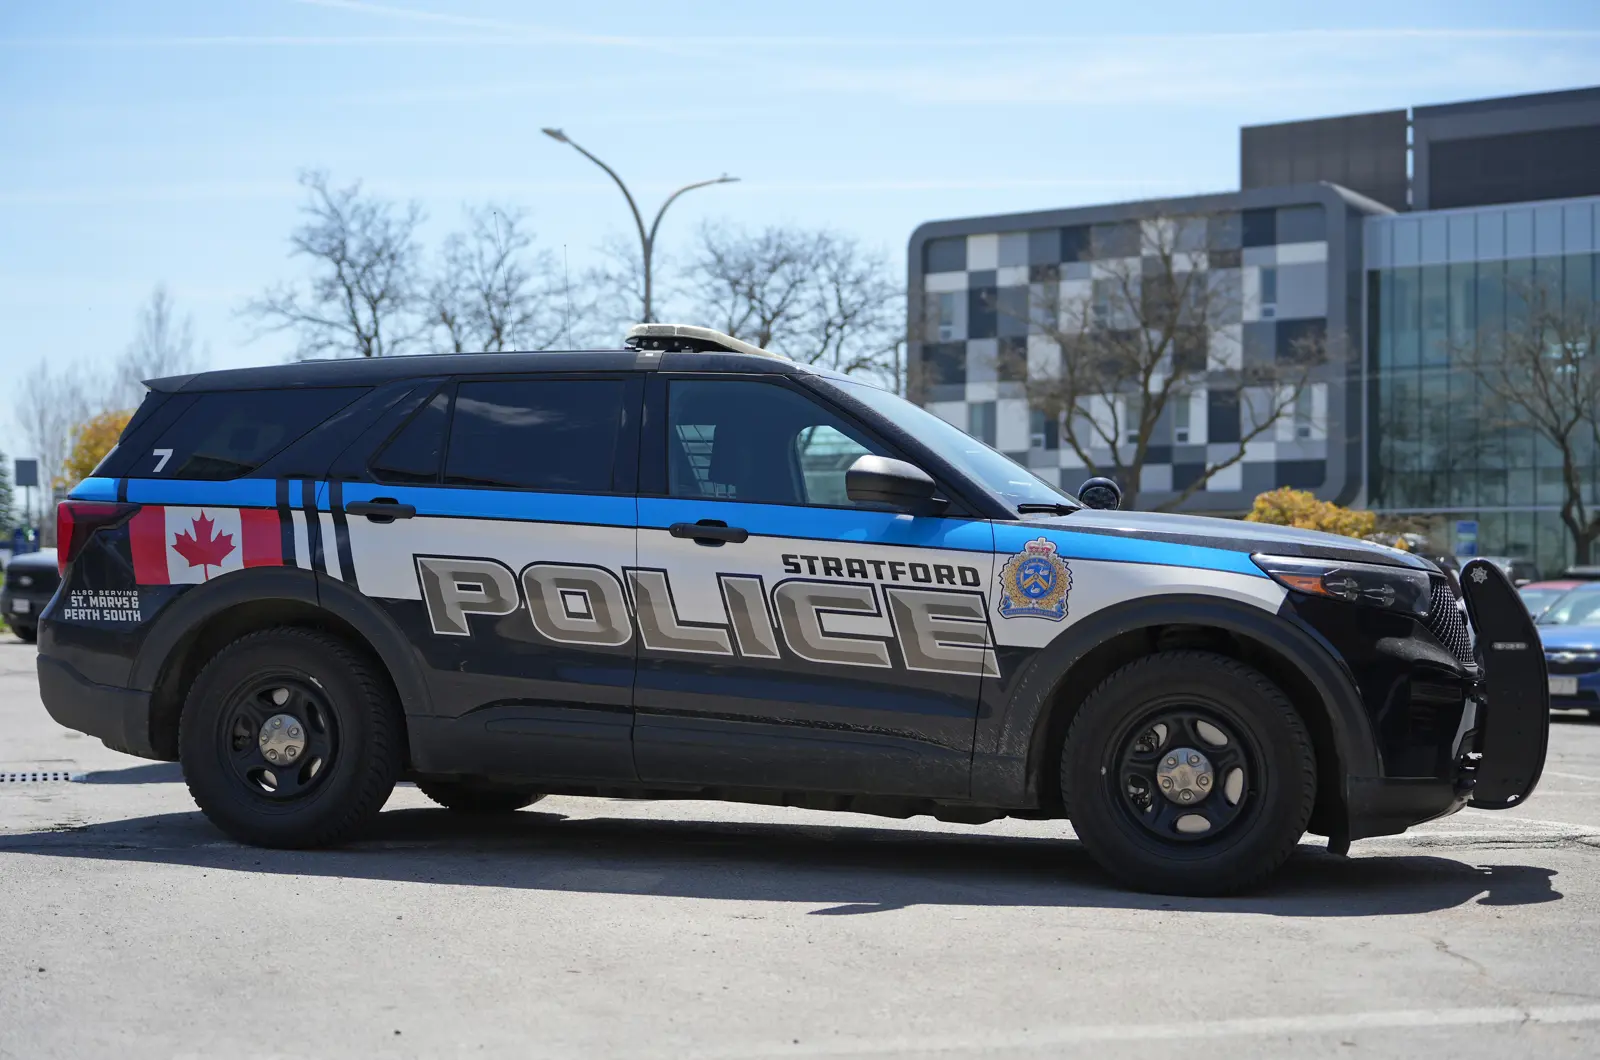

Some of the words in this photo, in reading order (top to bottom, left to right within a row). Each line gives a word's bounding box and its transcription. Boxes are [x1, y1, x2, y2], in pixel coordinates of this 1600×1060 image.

[152, 448, 174, 473] 7
[781, 553, 981, 587] STRATFORD
[64, 608, 101, 621] PERTH
[103, 609, 142, 622] SOUTH
[71, 596, 87, 607] ST.
[89, 596, 130, 609] MARYS
[131, 597, 140, 609] &
[412, 553, 1001, 678] POLICE
